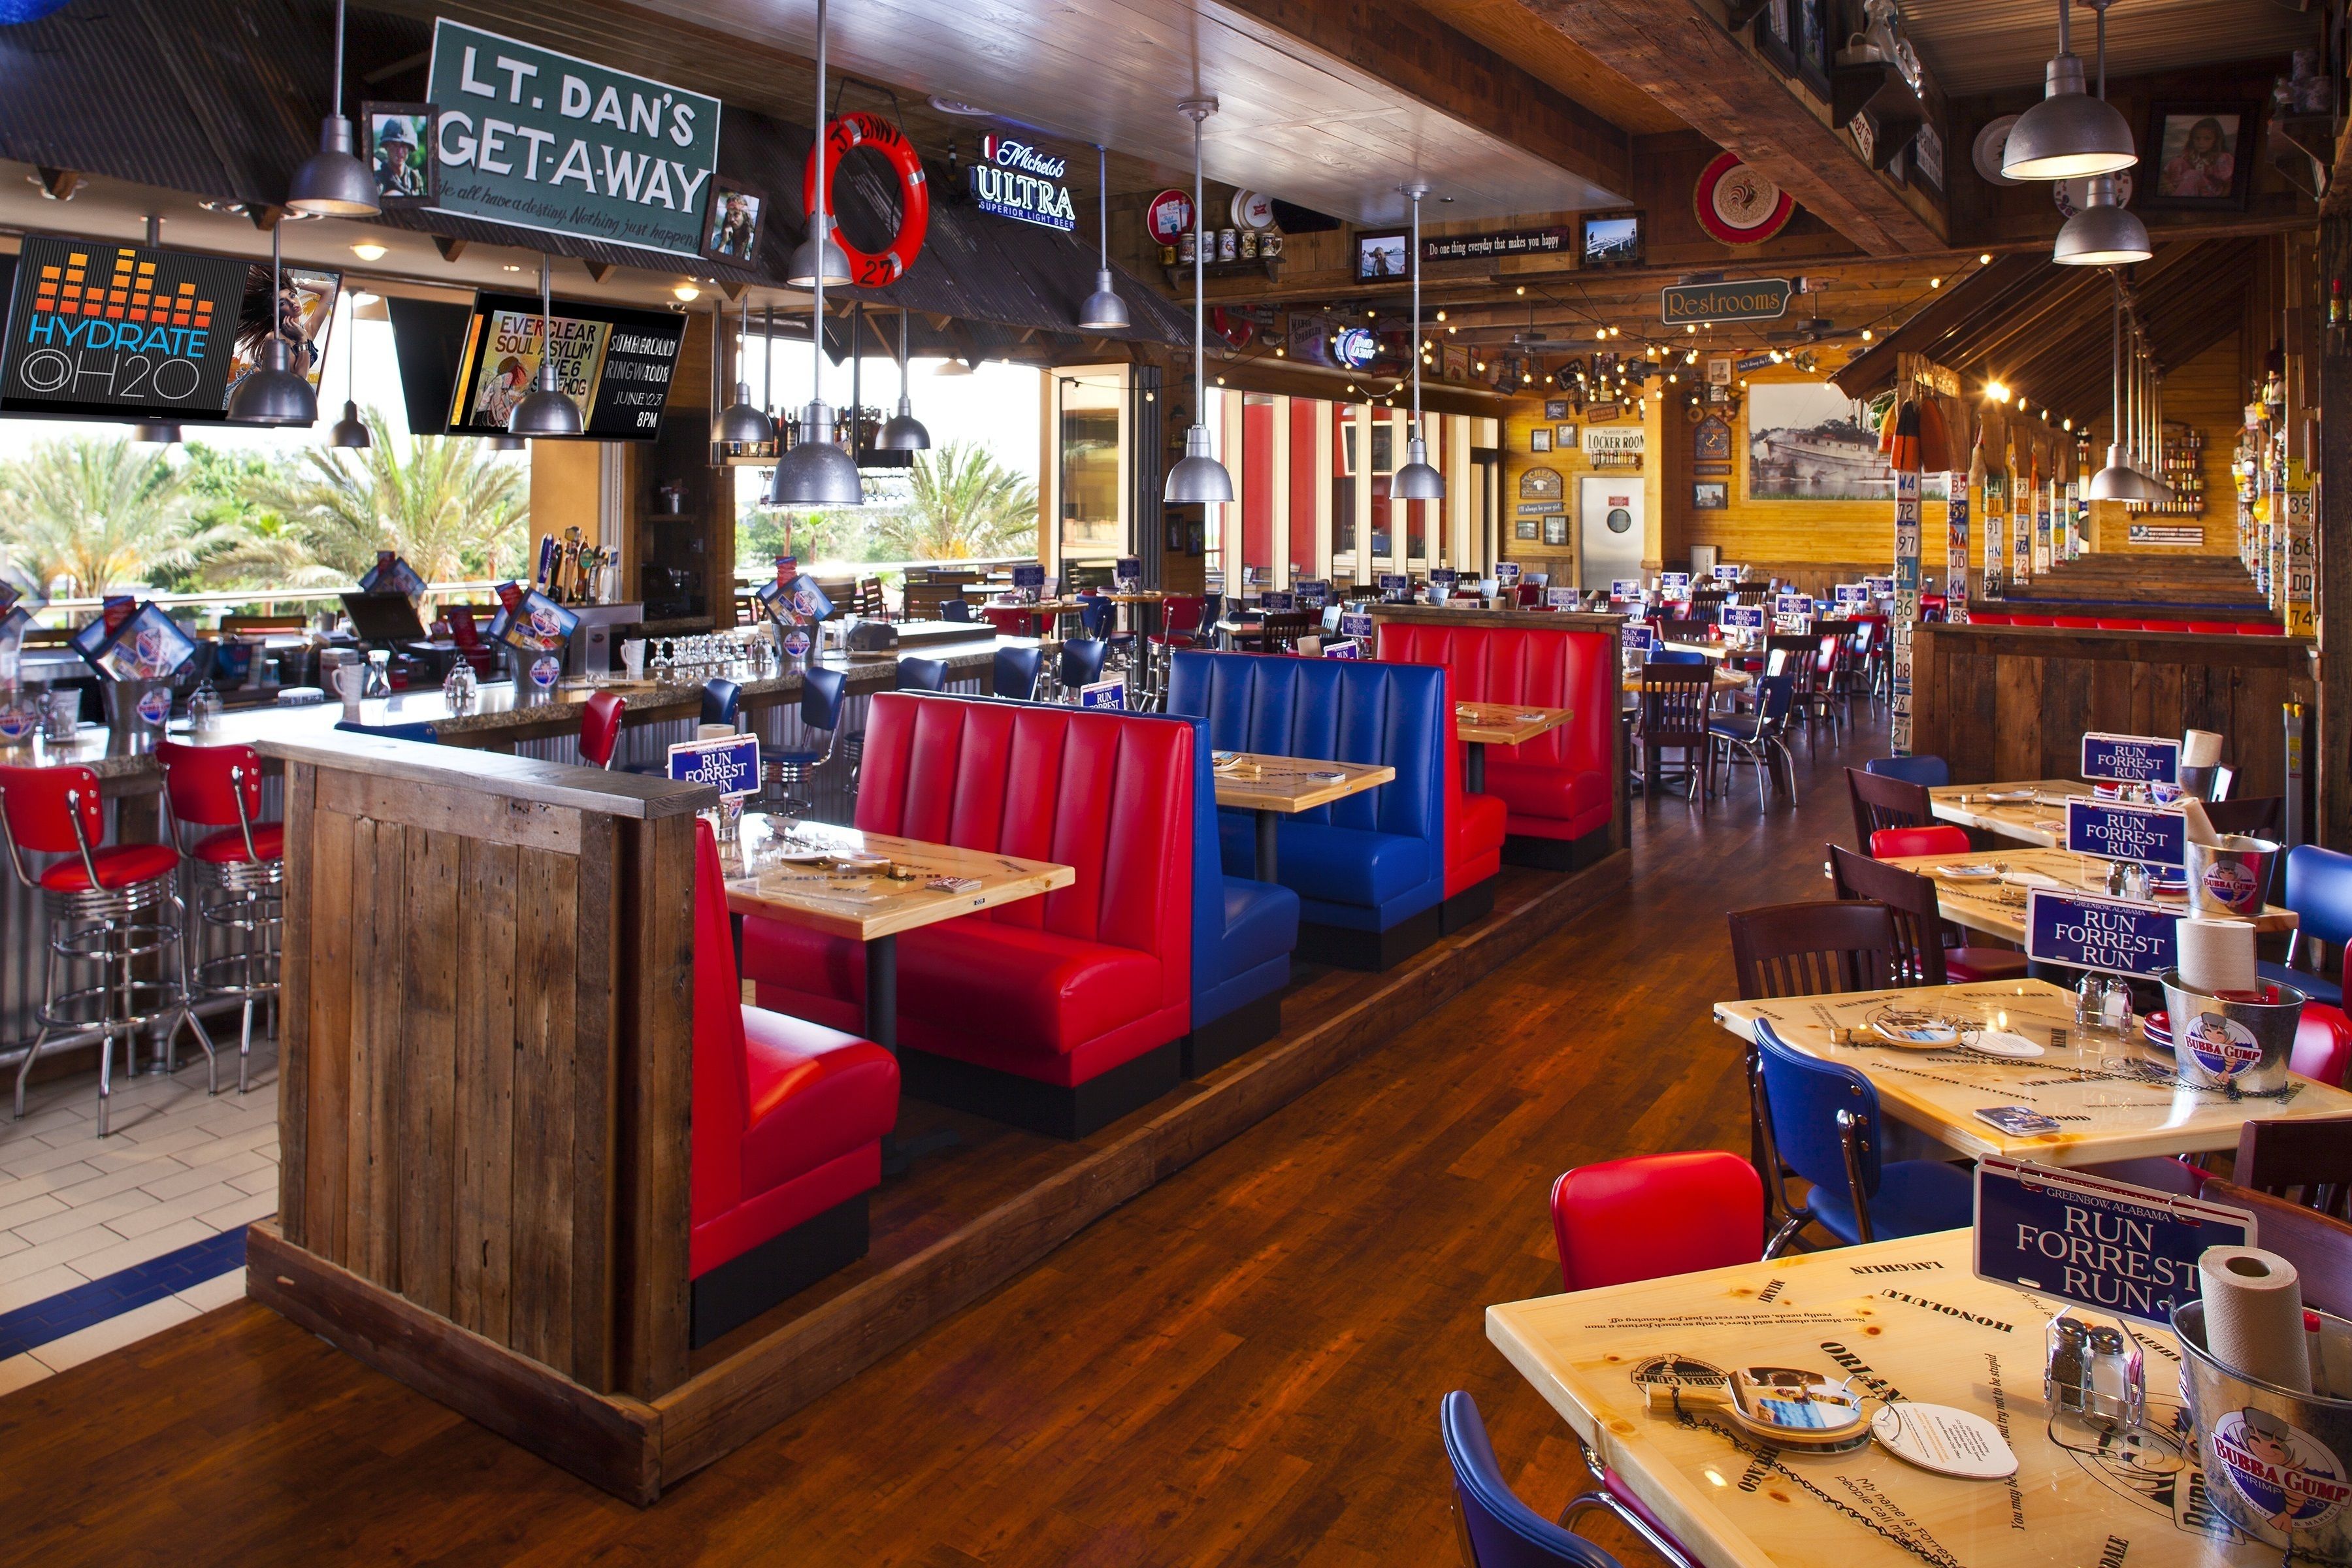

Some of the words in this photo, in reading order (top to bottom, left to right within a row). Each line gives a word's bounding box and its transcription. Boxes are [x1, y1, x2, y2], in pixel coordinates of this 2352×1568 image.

[461, 46, 543, 109] LT.
[561, 74, 696, 147] DAN'S
[997, 141, 1066, 178] Michelob
[977, 165, 1075, 220] ULTRA
[459, 186, 481, 202] all
[481, 190, 512, 209] have
[569, 206, 621, 236] Nothing
[619, 218, 648, 238] just
[980, 201, 1024, 218] SUPERIOR
[1027, 211, 1051, 224] LIGHT
[1054, 218, 1075, 230] BEER
[1429, 244, 1438, 255] Do
[1440, 245, 1450, 254] one
[1451, 241, 1466, 255] thing
[1468, 238, 1493, 255] everyday
[1494, 237, 1505, 250] that
[1509, 235, 1526, 249] makes
[1528, 238, 1539, 250] you
[1542, 233, 1560, 249] happy
[859, 261, 894, 286] 27
[1668, 291, 1781, 317] Restrooms
[28, 314, 209, 358] HYDRATE
[500, 316, 596, 342] EVERCLEAR
[495, 335, 533, 355] SOUL
[571, 360, 581, 378] 6
[637, 411, 658, 428] 8PM
[1588, 434, 1620, 449] LOCKER
[1899, 474, 1915, 491] W4
[1898, 504, 1913, 520] 72
[2289, 497, 2310, 514] 39
[1899, 536, 1915, 555] 97
[1988, 546, 2001, 557] HN
[1895, 599, 1913, 616] 86
[2291, 610, 2313, 627] 74
[1096, 691, 1113, 703] RUN
[702, 751, 732, 769] RUN
[2115, 745, 2146, 757] RUN
[685, 762, 747, 783] FORREST
[2098, 754, 2164, 770] FORREST
[2114, 766, 2146, 779] RUN
[2107, 814, 2146, 831] RUN
[2085, 824, 2168, 847] FORREST
[2107, 841, 2146, 858] RUN
[2202, 877, 2231, 889] BUBBA
[2232, 881, 2257, 892] GUMP
[2074, 901, 2112, 913] GREENBOW,
[2112, 906, 2146, 916] ALABAMA
[2083, 911, 2136, 934] RUN
[2055, 923, 2165, 955] FORREST
[2082, 945, 2135, 970] RUN
[2185, 1036, 2222, 1055] BUBBA
[2224, 1045, 2261, 1061] GUMP
[2195, 1051, 2224, 1061] SHRIMP
[1932, 1075, 1961, 1086] PIER
[1968, 1083, 2039, 1102] GALVESTON
[2046, 1187, 2110, 1209] GREENBOW,
[2112, 1202, 2171, 1223] ALABAMA
[2063, 1205, 2154, 1251] RUN
[2017, 1223, 2200, 1291] FORREST
[1849, 1261, 1945, 1275] LAUGHLIN
[1757, 1279, 1786, 1304] MIAMI
[2063, 1265, 2153, 1314] RUN
[1880, 1288, 2015, 1333] HONOLULU
[1984, 1352, 2002, 1377] stupid
[1635, 1375, 1682, 1386] GUMP
[1989, 1375, 2001, 1386] be
[1993, 1385, 2003, 1394] to
[1994, 1394, 2007, 1411] not
[1997, 1411, 2010, 1425] try
[2213, 1437, 2280, 1485] BUBBA
[2283, 1471, 2351, 1503] GUMP
[2004, 1477, 2018, 1488] be
[2232, 1468, 2283, 1495] SHRIMP
[2304, 1497, 2327, 1509] CO
[1835, 1475, 1873, 1505] people
[1870, 1505, 1895, 1524] call
[2010, 1487, 2023, 1512] may
[2223, 1463, 2269, 1518] RESTAURANT
[2304, 1506, 2338, 1527] MARKET
[1855, 1477, 1878, 1493] My
[1873, 1492, 1906, 1518] name
[1902, 1518, 1917, 1527] is
[1912, 1526, 1959, 1564] Forrest
[2011, 1511, 2025, 1531] You
